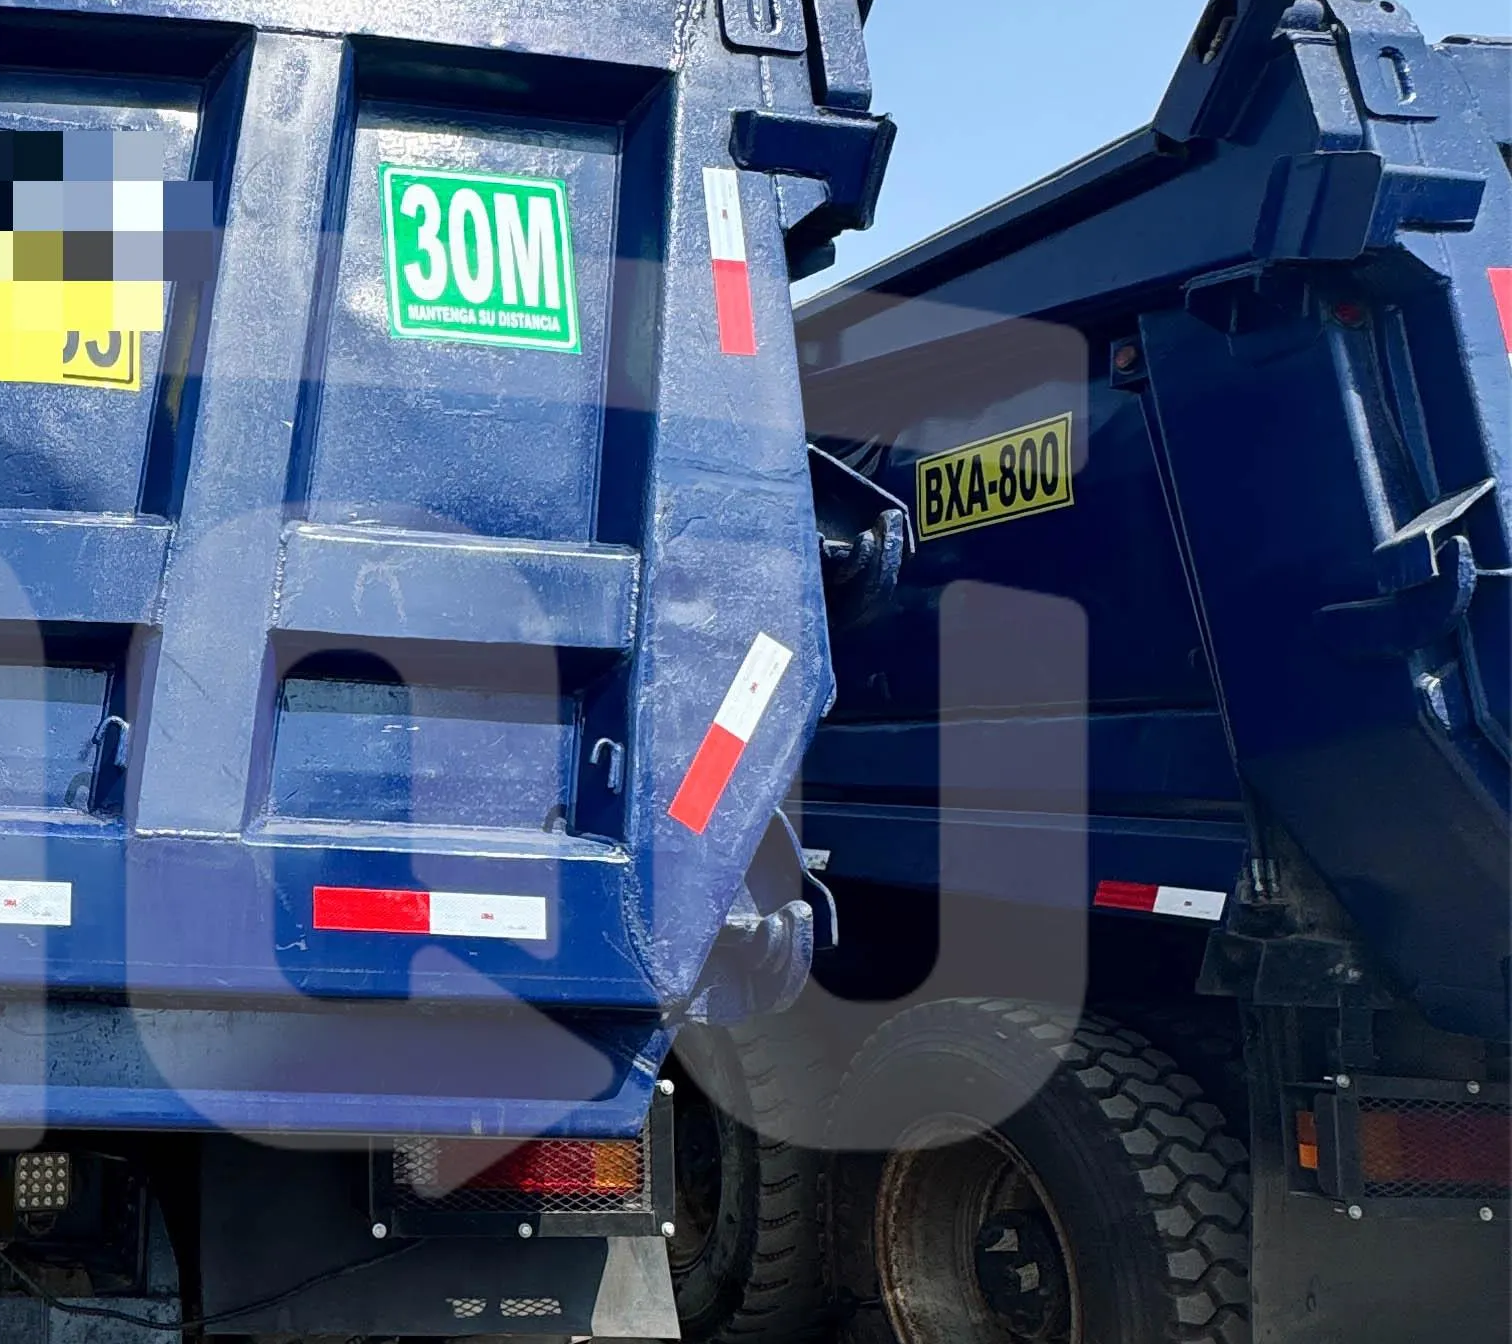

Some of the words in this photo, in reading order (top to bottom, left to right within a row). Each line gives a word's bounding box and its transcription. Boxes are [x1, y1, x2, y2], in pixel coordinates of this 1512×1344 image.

[400, 183, 560, 310] 30M
[408, 304, 477, 325] MANTENGA
[478, 309, 495, 327] SU
[498, 311, 561, 333] DISTANCIA
[925, 431, 1059, 526] BXA-800
